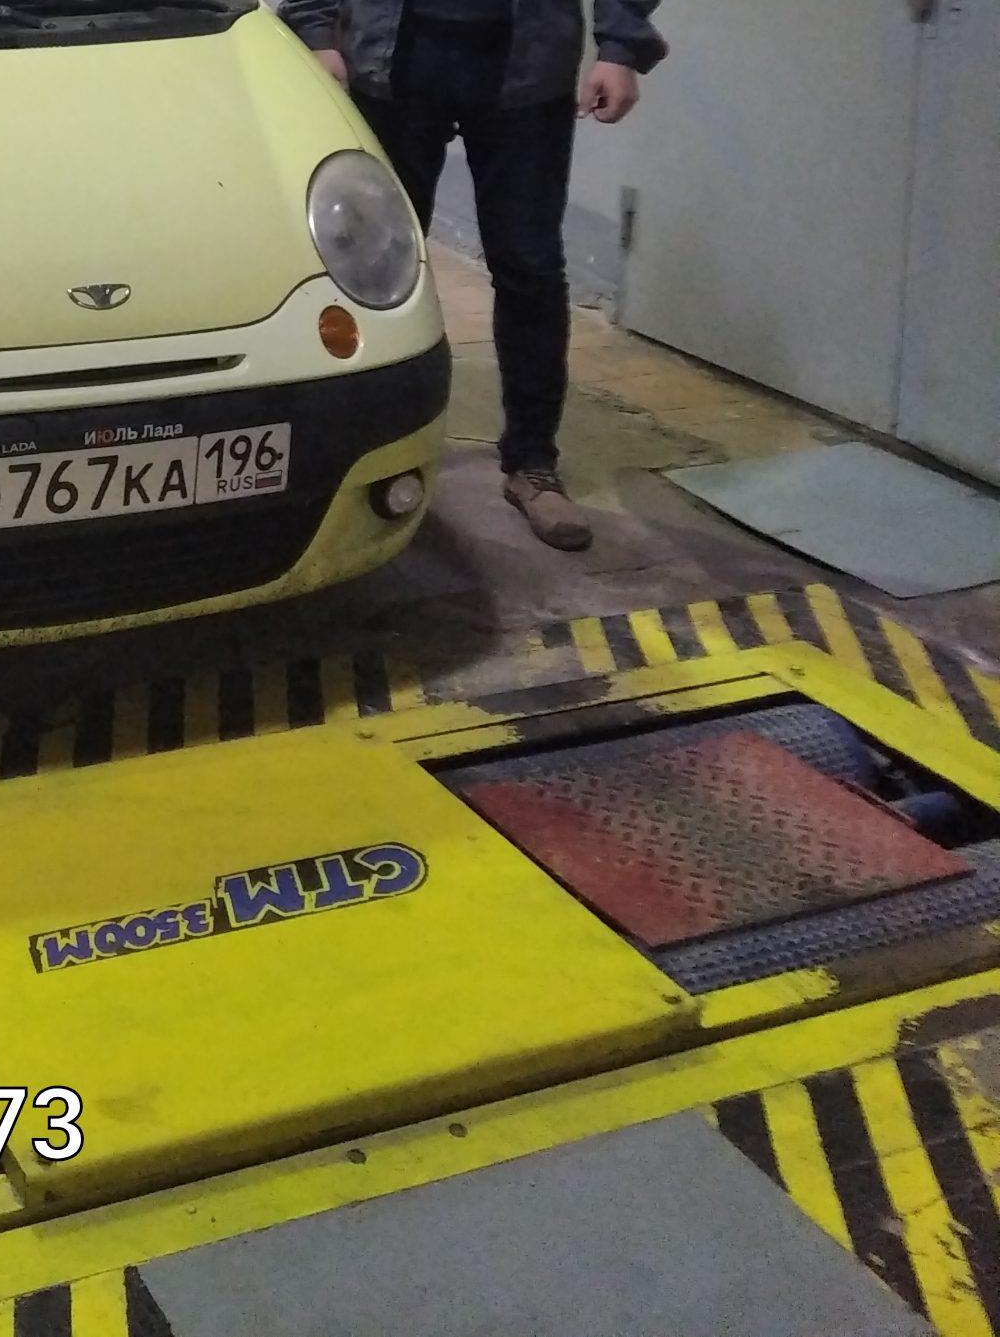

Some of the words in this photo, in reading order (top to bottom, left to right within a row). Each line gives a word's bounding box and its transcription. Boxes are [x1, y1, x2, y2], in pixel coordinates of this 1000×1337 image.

[140, 422, 184, 439] Лада
[1, 441, 38, 455] LADA
[205, 431, 279, 479] 196
[217, 476, 253, 496] RUS
